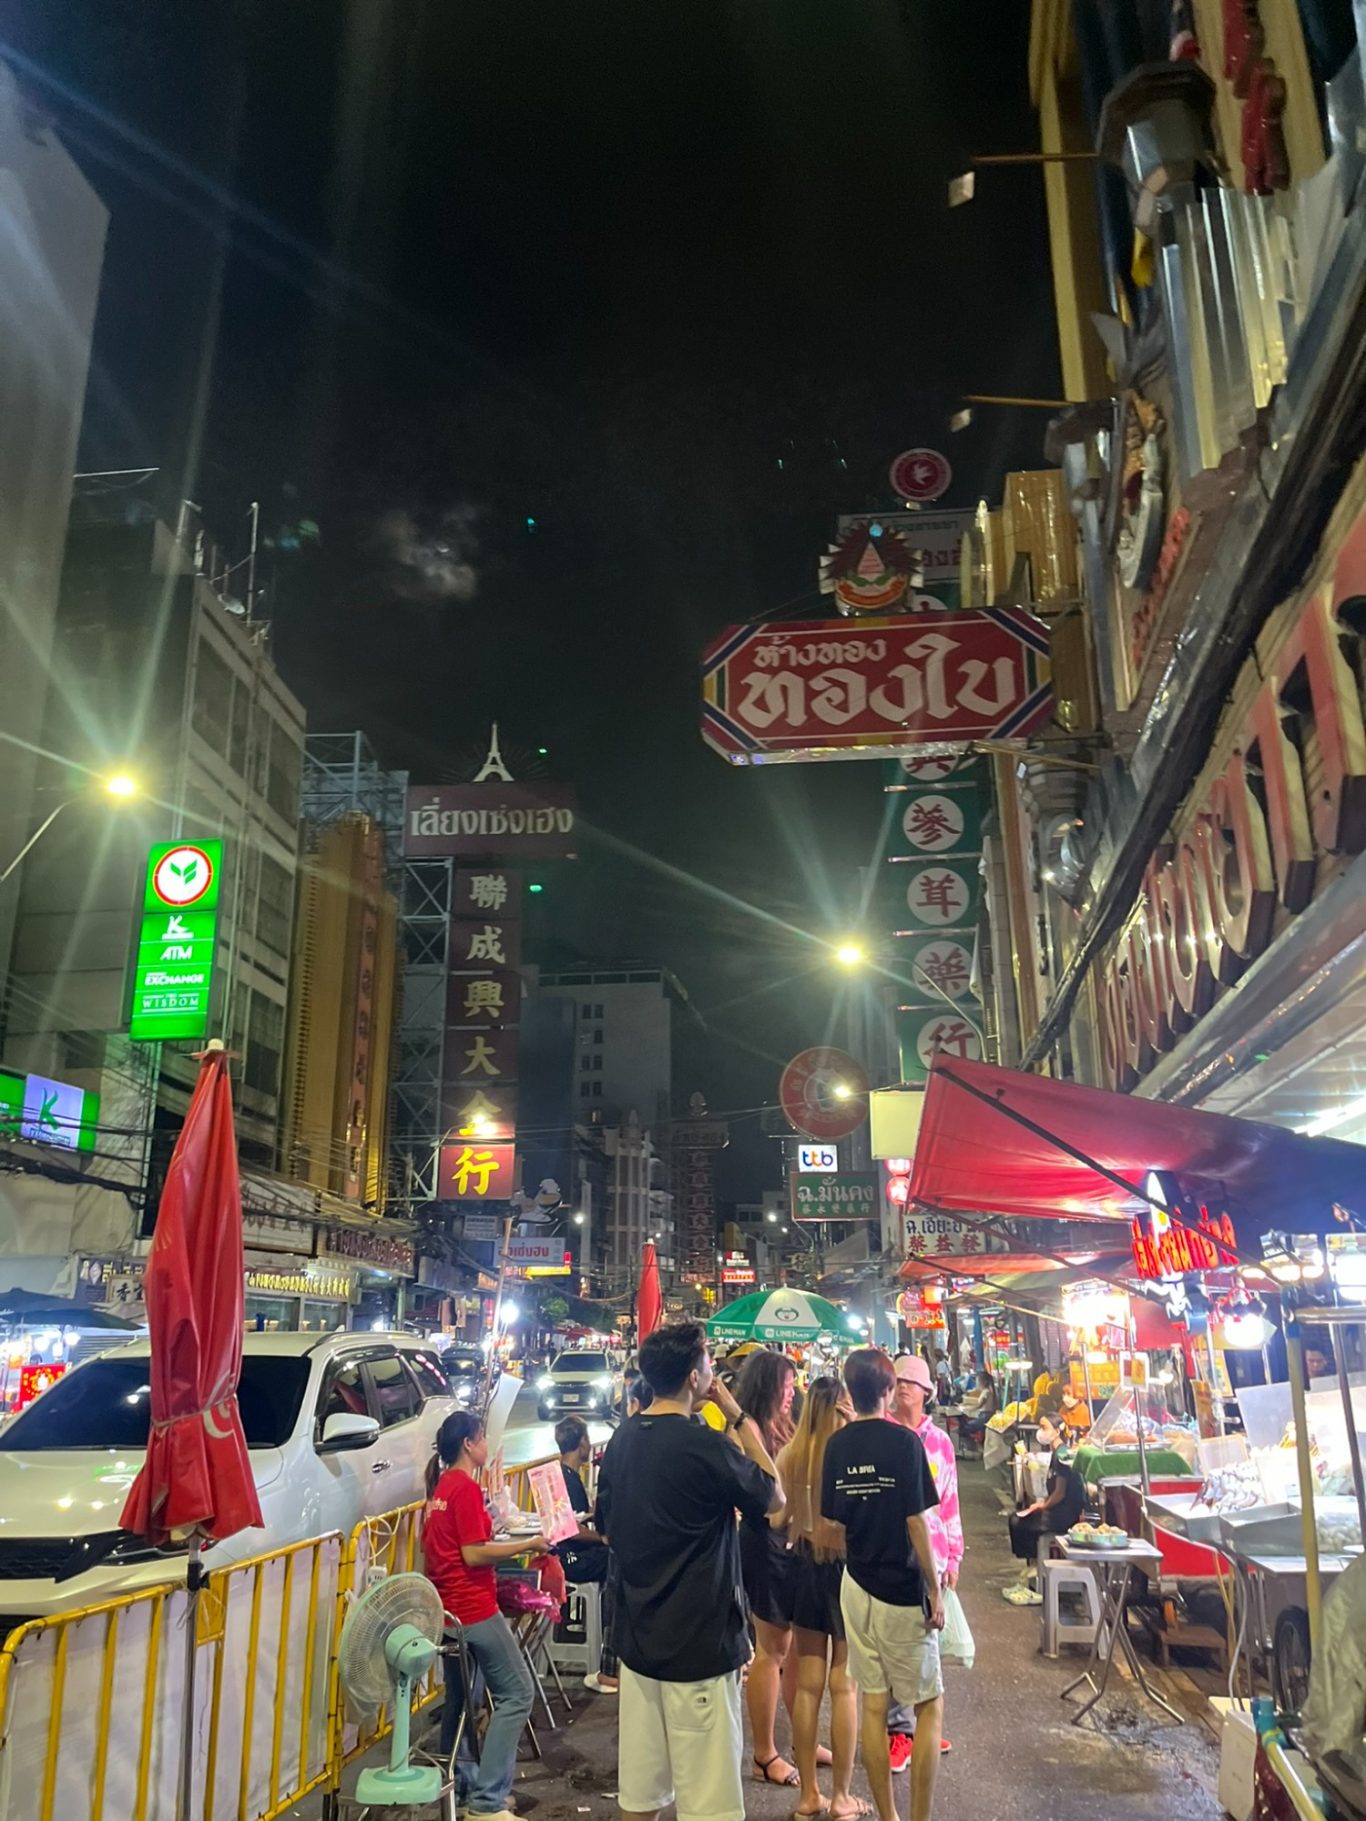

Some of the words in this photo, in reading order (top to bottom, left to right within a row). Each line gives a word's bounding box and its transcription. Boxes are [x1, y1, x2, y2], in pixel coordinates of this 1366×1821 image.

[753, 636, 887, 668] ห้างทอง
[737, 632, 1016, 728] ทองใบ
[160, 946, 193, 960] ATM
[144, 974, 204, 986] EXCHANGE
[142, 998, 198, 1008] WISDOM
[802, 1150, 834, 1167] ttb
[797, 1176, 874, 1202] ฉ.มั่นคง
